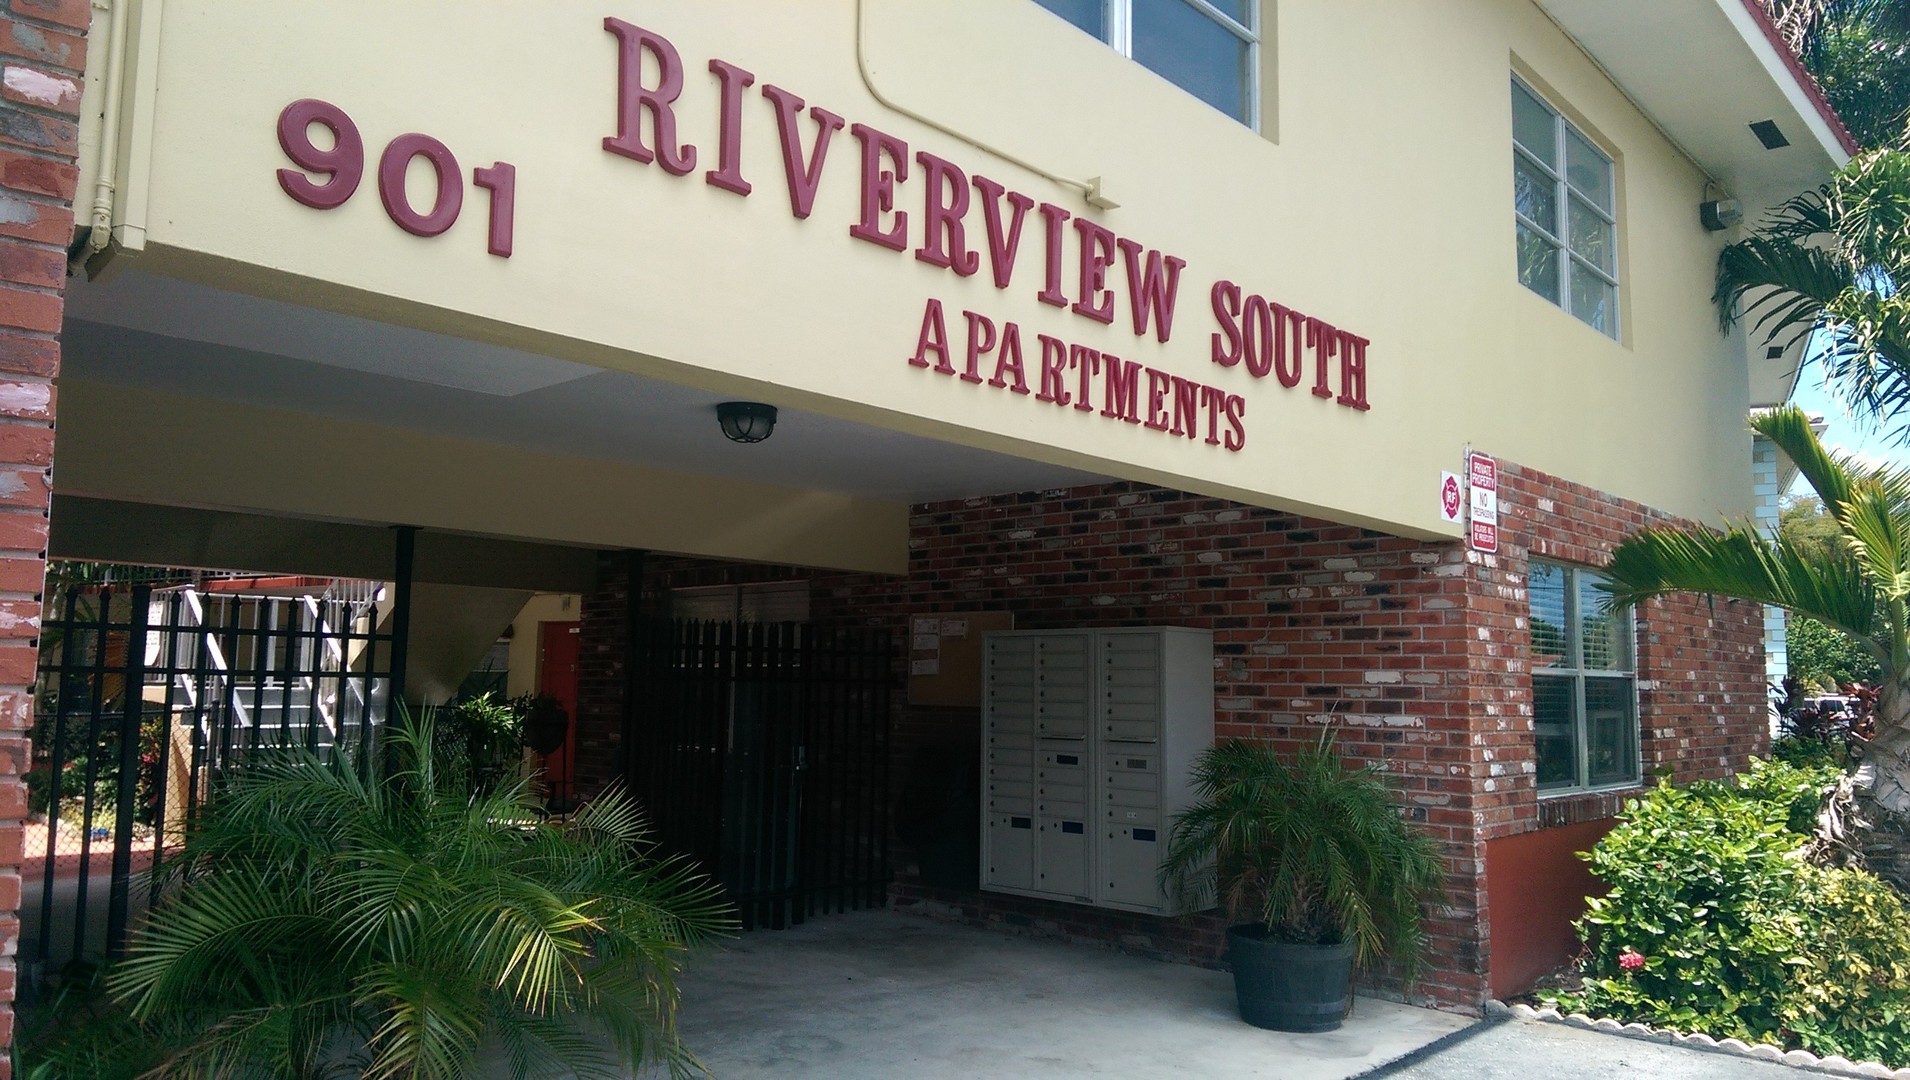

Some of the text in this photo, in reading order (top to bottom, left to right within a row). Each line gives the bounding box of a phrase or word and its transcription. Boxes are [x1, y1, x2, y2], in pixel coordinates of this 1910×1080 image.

[277, 98, 517, 258] 901
[603, 16, 1371, 411] RIVERVIEW SOUTH
[908, 298, 1246, 452] APARTMENTS
[1472, 472, 1494, 489] PROPERTY
[1474, 461, 1492, 477] PRIVATE
[1479, 491, 1488, 508] NO
